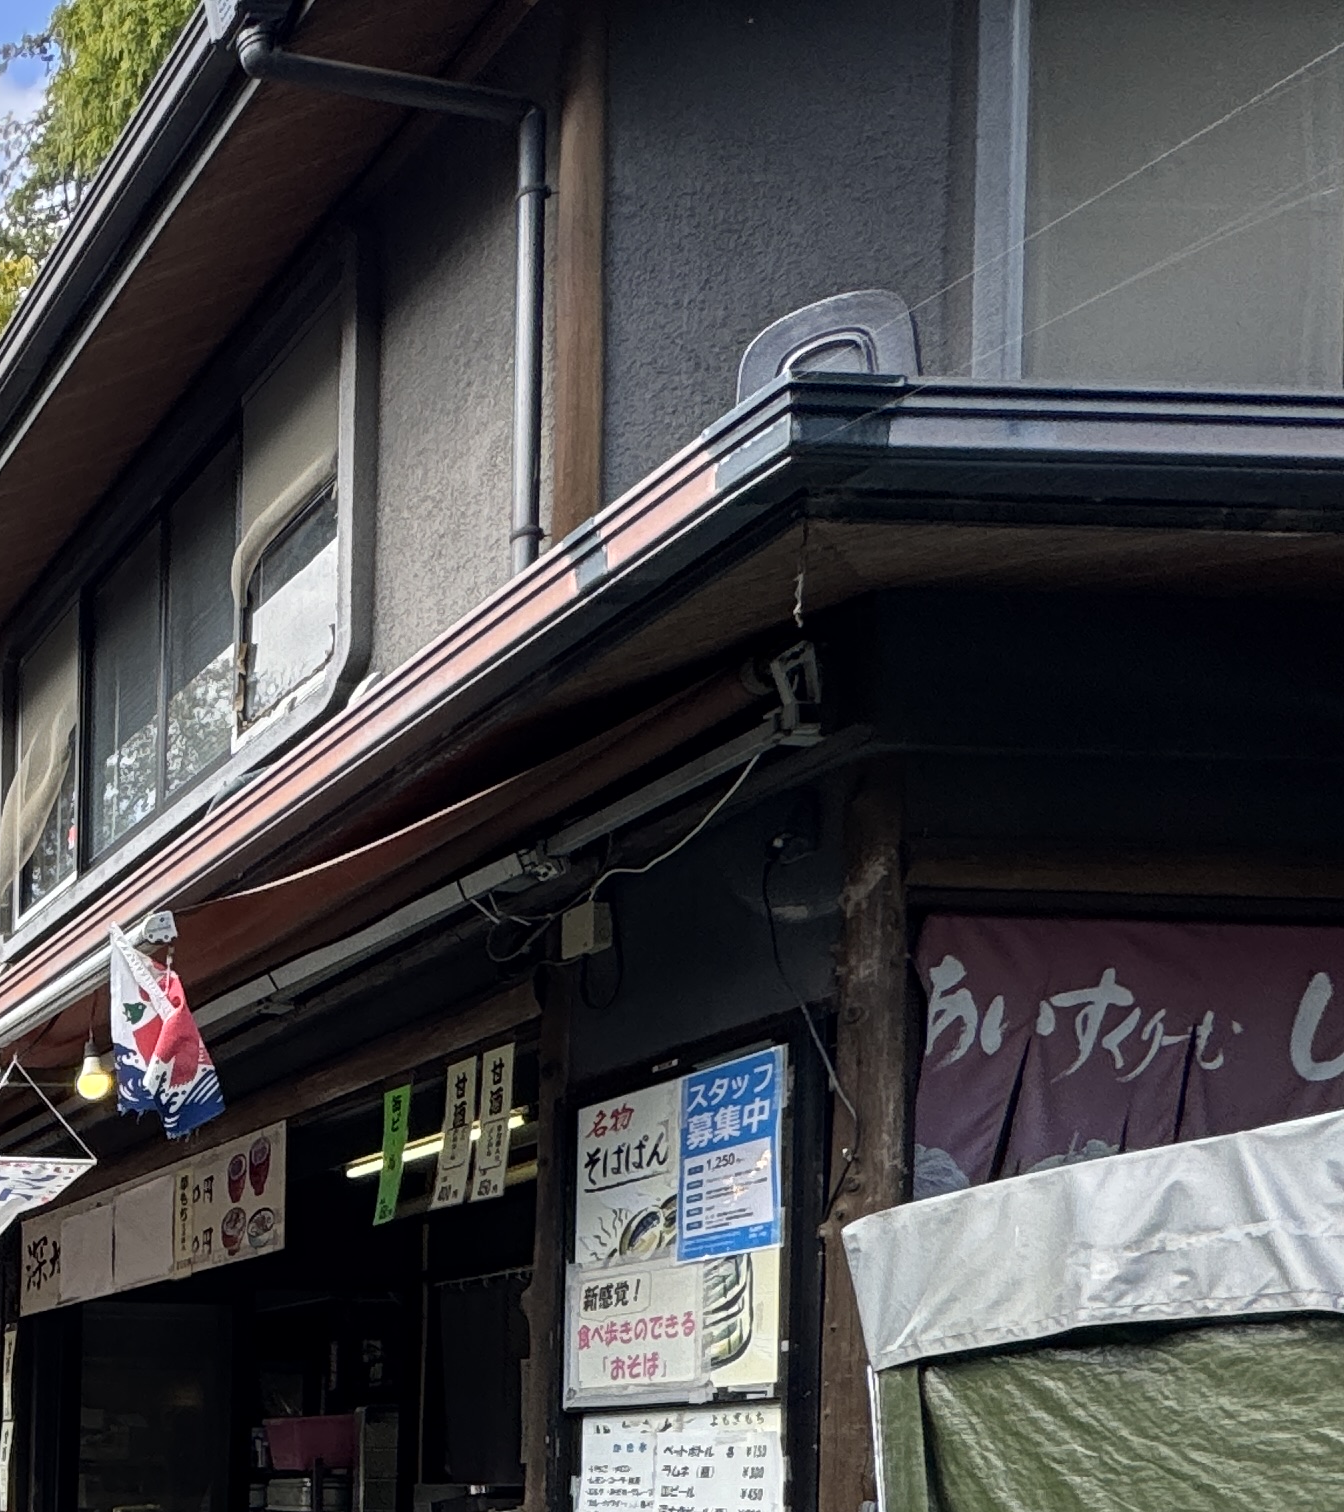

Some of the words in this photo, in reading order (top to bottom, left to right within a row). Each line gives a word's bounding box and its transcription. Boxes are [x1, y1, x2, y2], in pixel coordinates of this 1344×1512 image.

[926, 954, 1244, 1084] あいすくりーむ
[489, 1057, 505, 1116] 甘酒
[686, 1063, 774, 1114] スタッフ
[585, 1103, 635, 1139] 名物
[686, 1097, 771, 1151] 募集中
[584, 1133, 669, 1186] そばぱん
[582, 1278, 642, 1312] 新感覚!
[577, 1311, 696, 1350] 食べ歩きのできる
[602, 1352, 667, 1380] 「おそば」
[710, 1412, 765, 1427] よもぎもち
